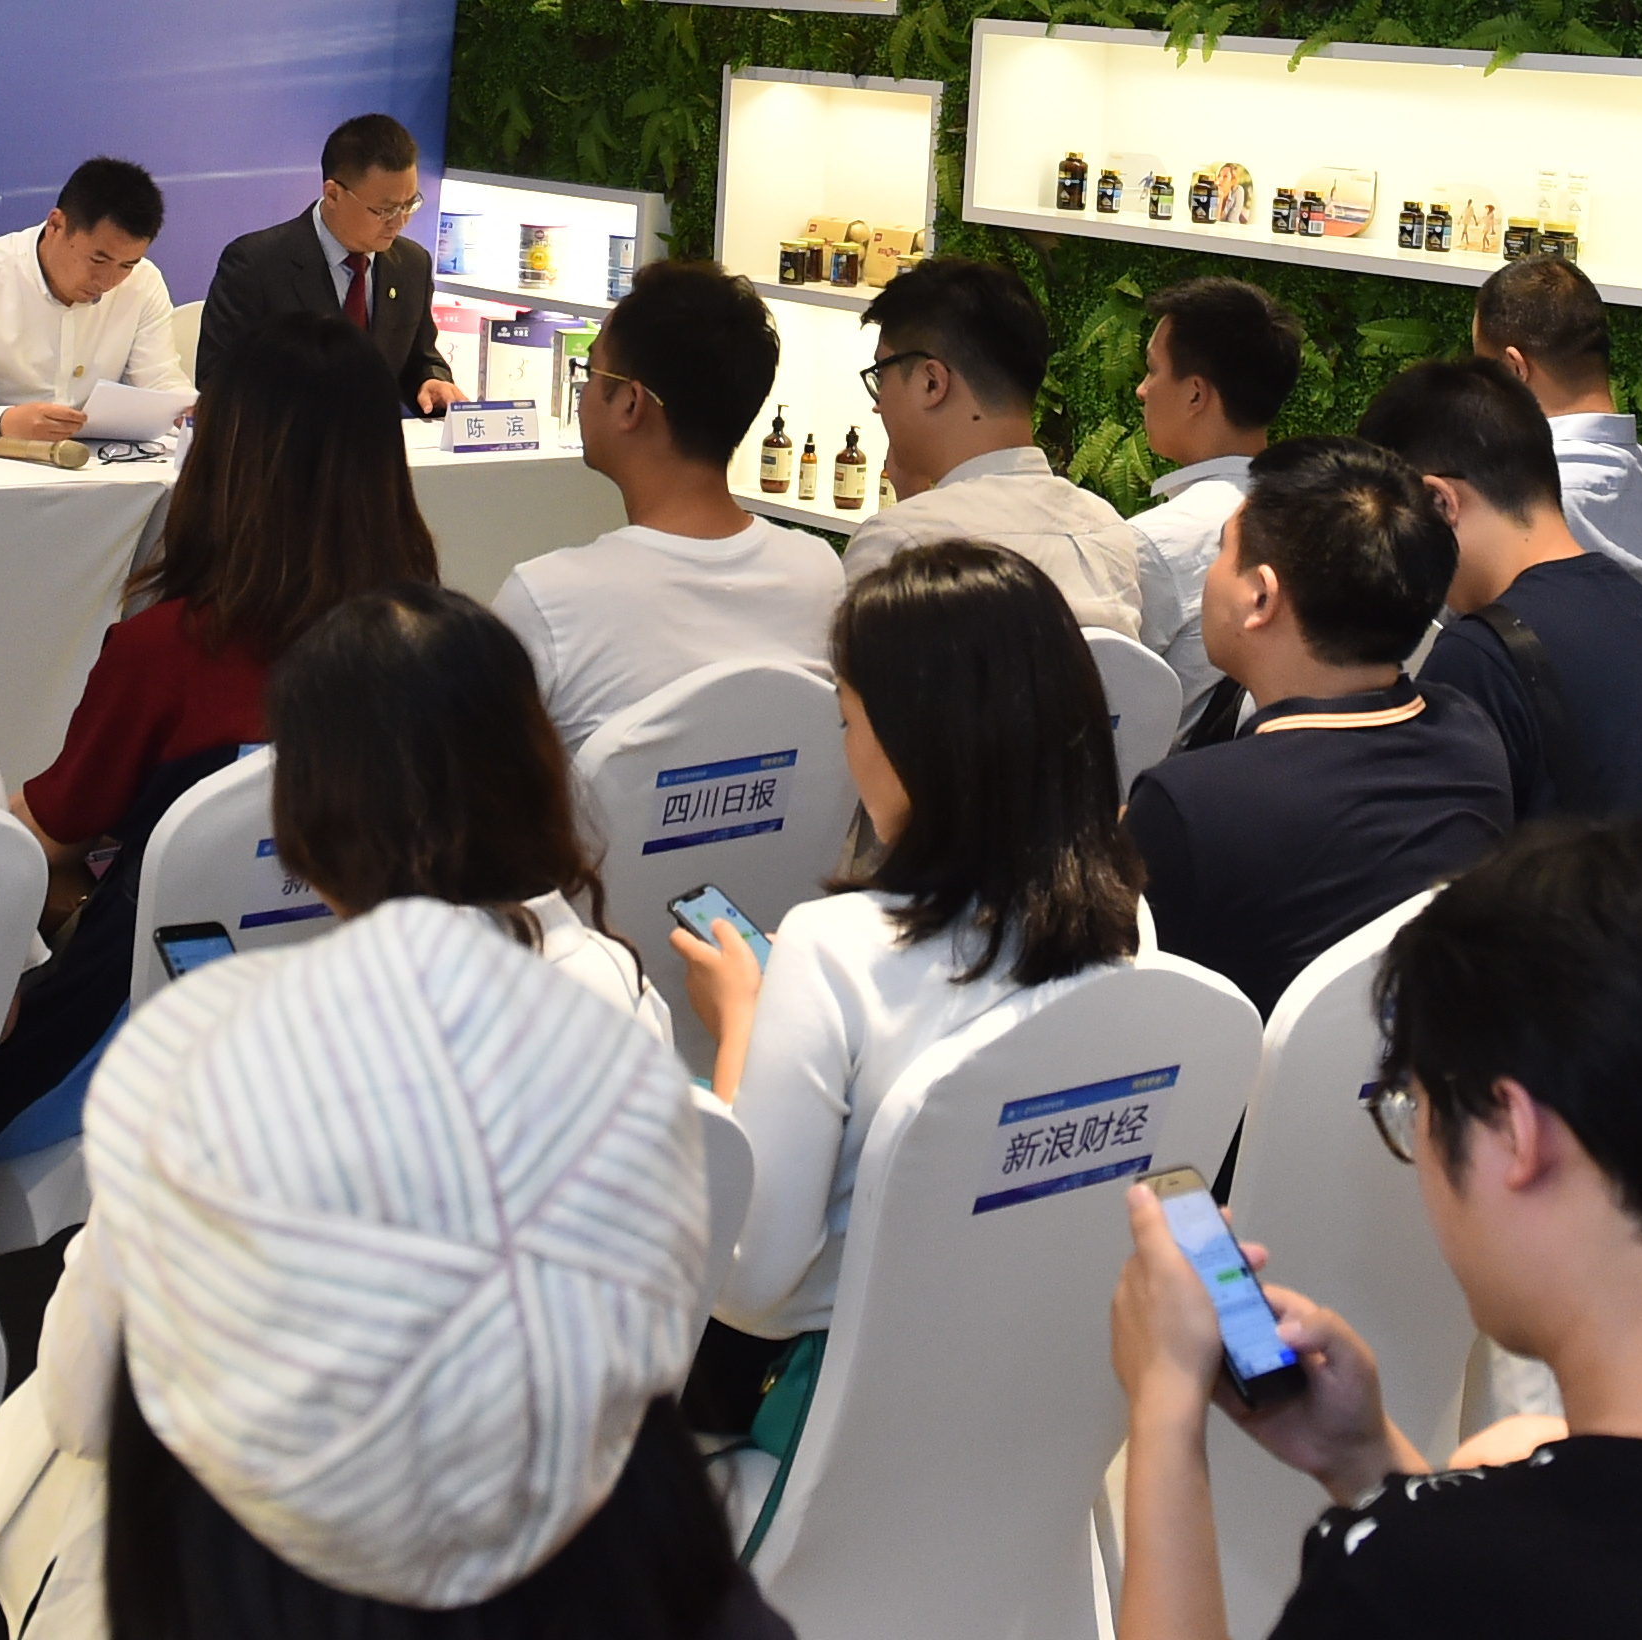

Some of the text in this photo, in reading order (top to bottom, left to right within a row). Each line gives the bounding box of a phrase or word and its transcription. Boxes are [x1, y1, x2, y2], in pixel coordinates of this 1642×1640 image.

[662, 778, 777, 827] 四川日报
[1002, 1104, 1150, 1175] 新浪财经
